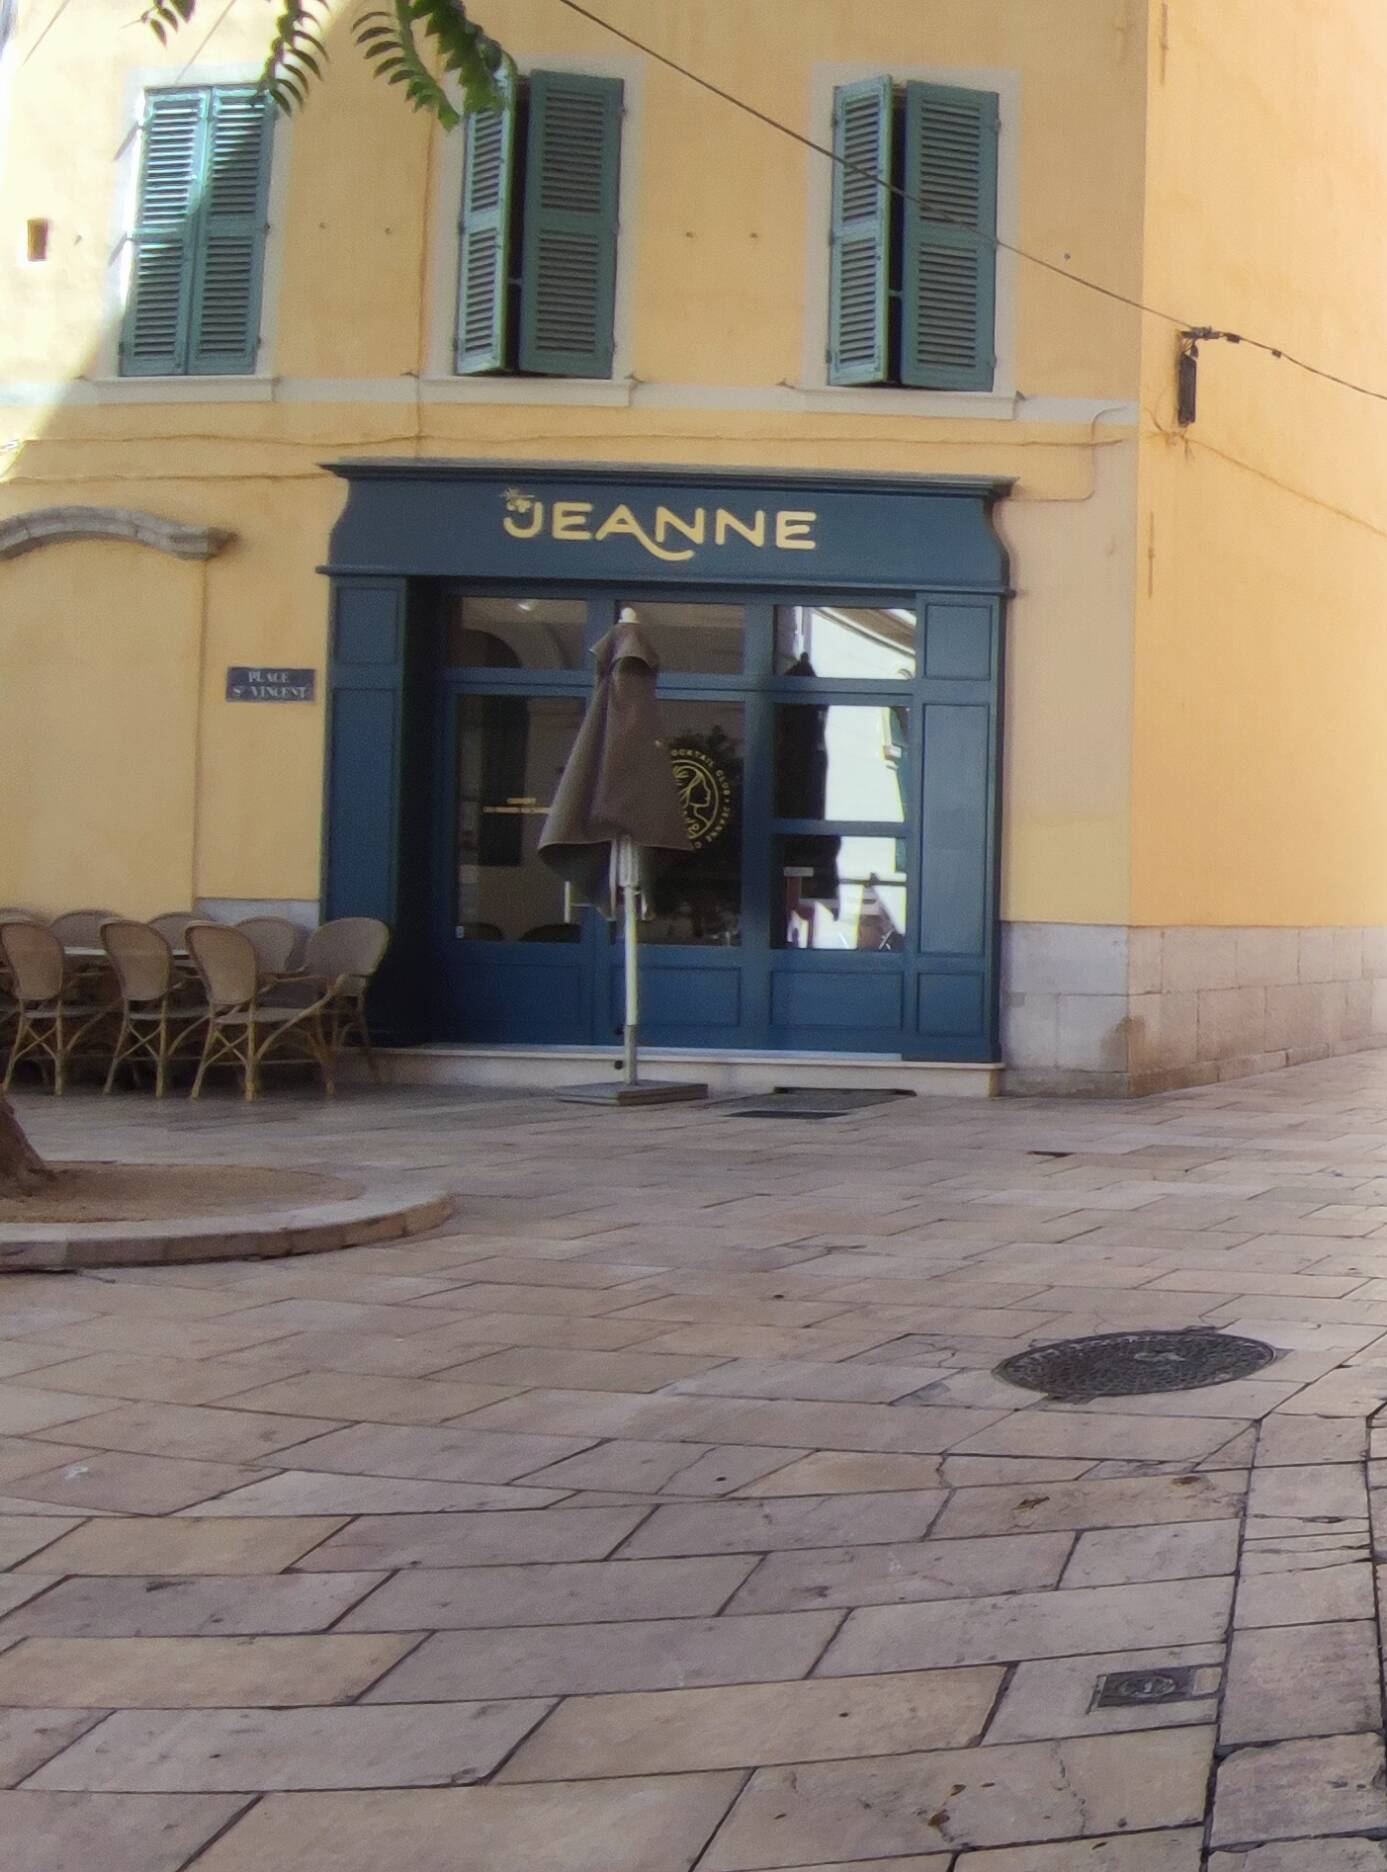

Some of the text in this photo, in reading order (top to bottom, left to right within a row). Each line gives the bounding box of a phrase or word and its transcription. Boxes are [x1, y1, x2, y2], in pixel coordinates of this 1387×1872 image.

[503, 496, 816, 561] JEANNE
[248, 671, 288, 683] PLACE
[250, 686, 306, 698] VINCENT
